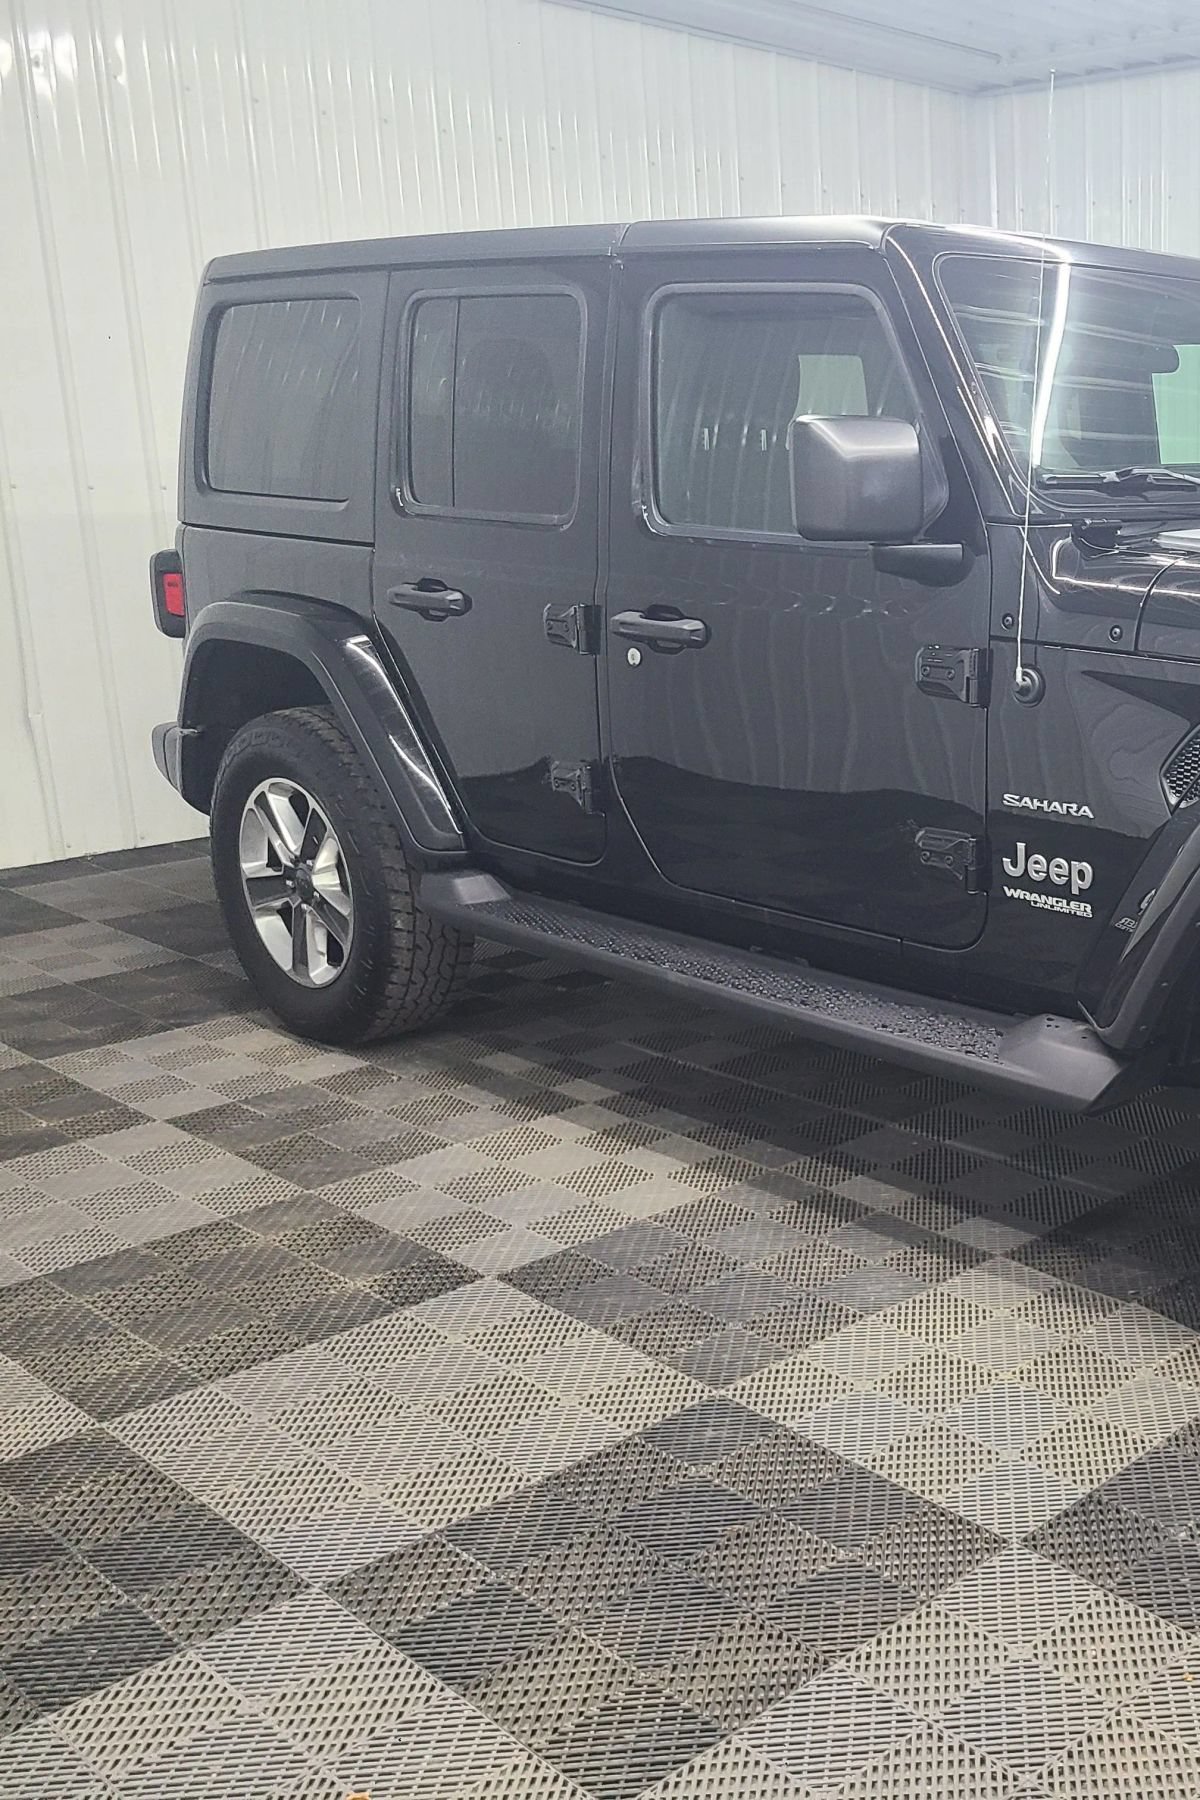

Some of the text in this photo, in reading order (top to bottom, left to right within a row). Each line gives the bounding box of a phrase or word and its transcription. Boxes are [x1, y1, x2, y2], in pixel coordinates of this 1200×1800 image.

[1002, 793, 1094, 819] SAHARA
[1002, 842, 1093, 895] Jeep
[1003, 886, 1092, 913] WRANGLER
[1031, 900, 1093, 918] UNLIMITED
